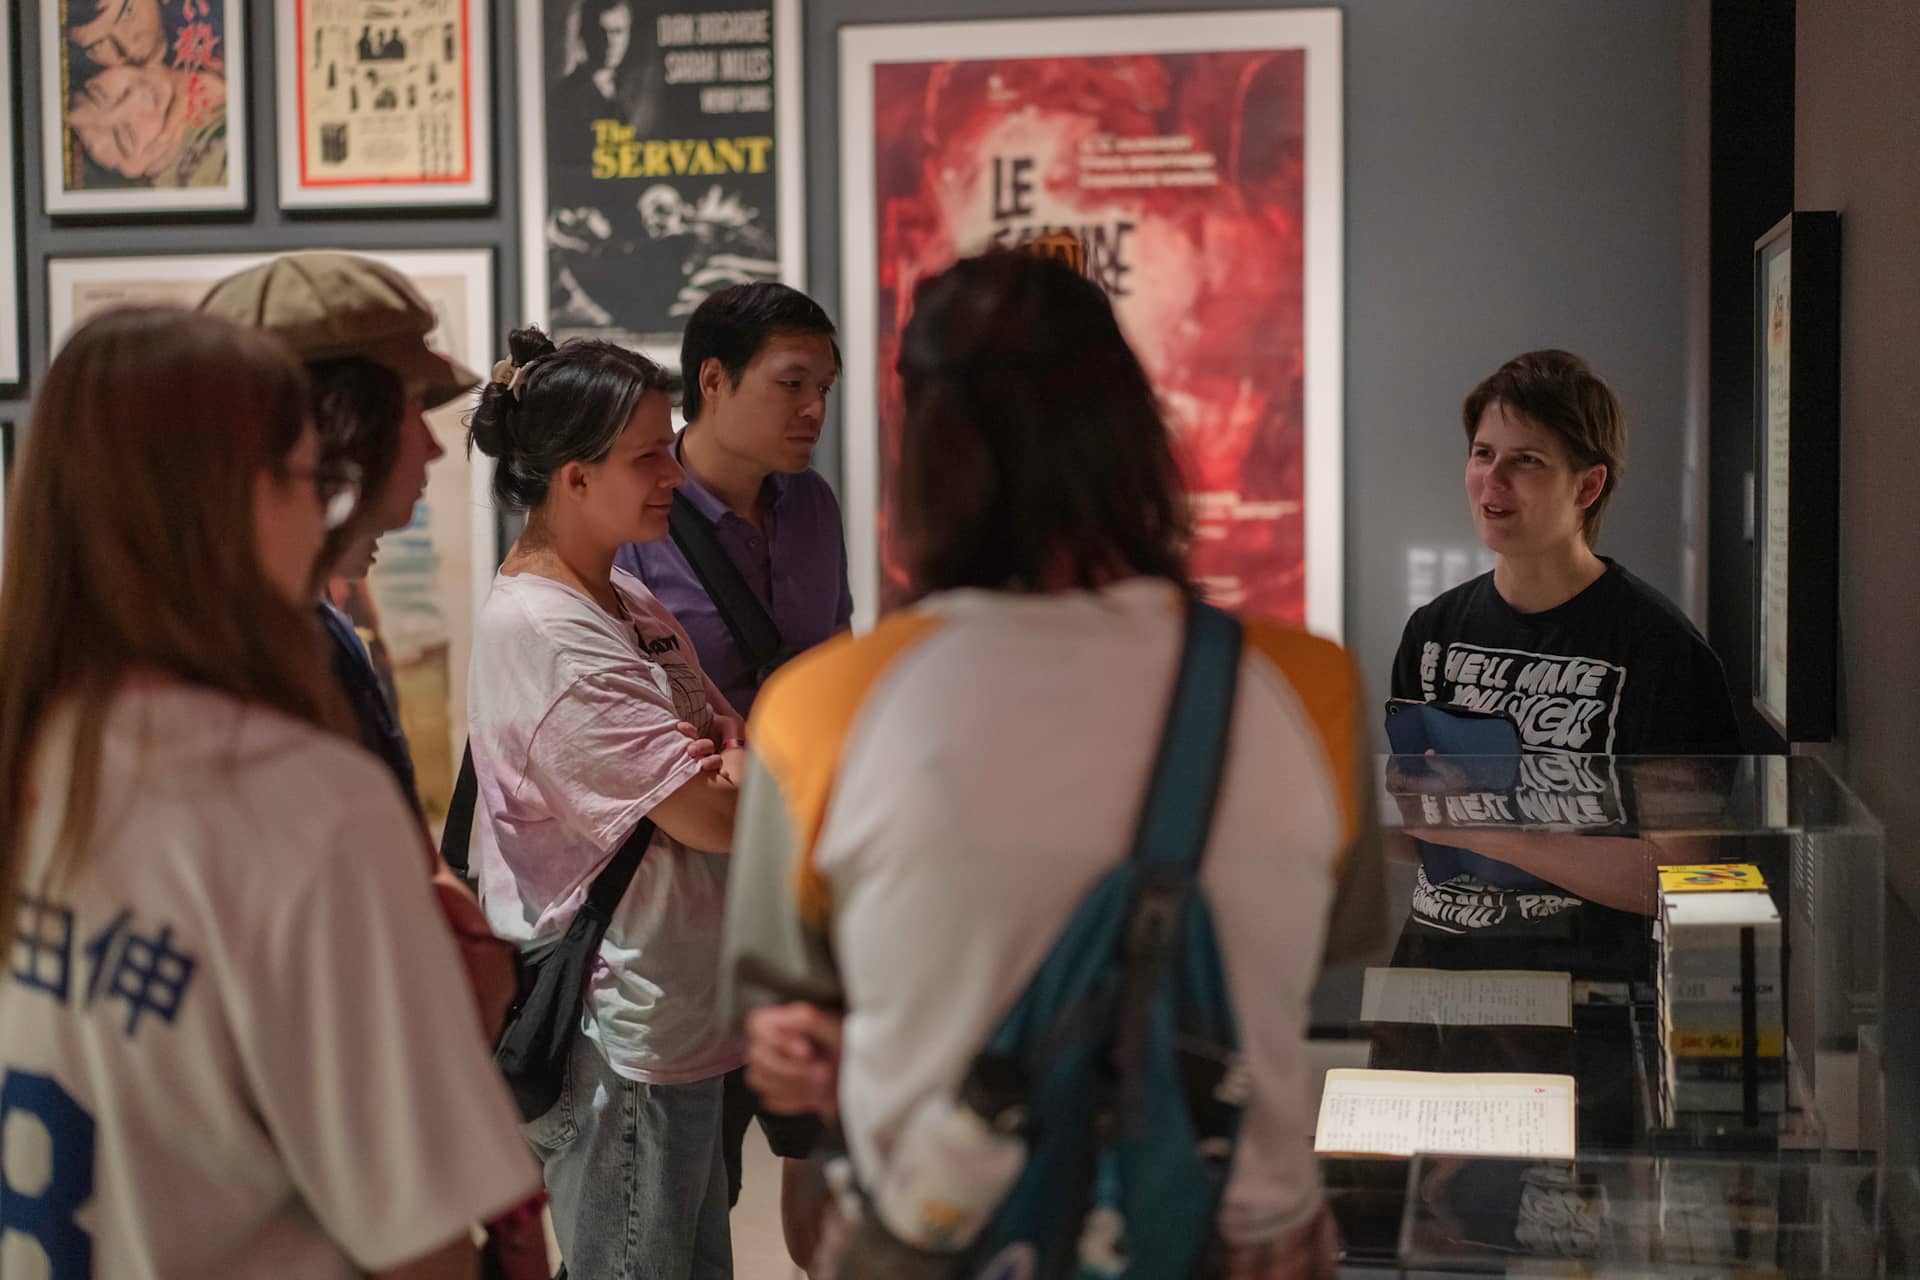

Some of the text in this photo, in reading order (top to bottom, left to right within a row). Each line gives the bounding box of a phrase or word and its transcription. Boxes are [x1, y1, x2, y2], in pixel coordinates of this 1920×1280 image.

[592, 119, 638, 142] The
[592, 137, 772, 179] SERVANT
[993, 157, 1034, 220] LE
[1515, 660, 1607, 696] MAKE
